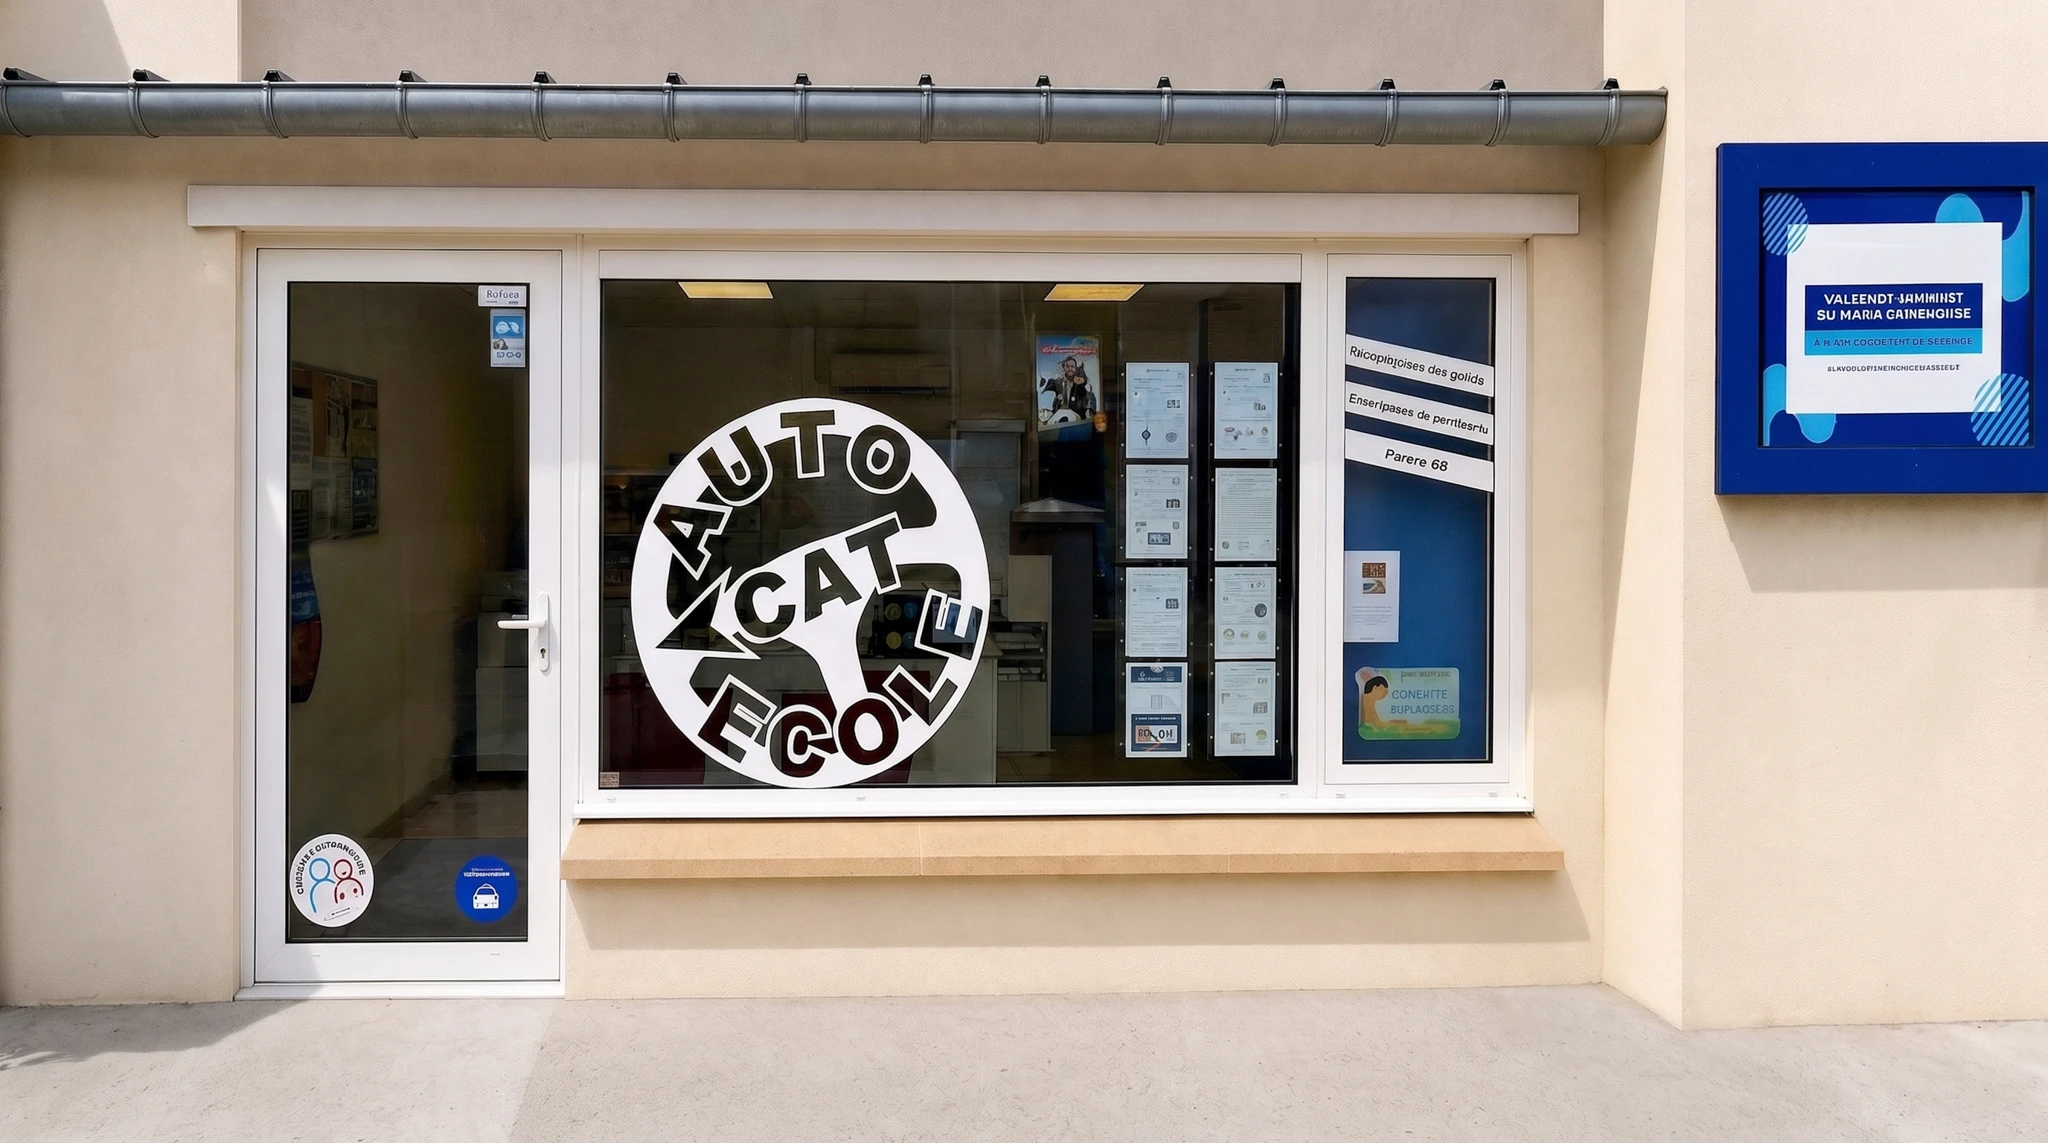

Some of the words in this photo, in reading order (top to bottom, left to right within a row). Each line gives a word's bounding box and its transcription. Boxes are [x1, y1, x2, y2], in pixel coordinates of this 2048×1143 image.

[1816, 309, 1836, 321] SU
[1840, 309, 1882, 320] MARIA
[1912, 338, 1925, 346] DE
[1428, 365, 1448, 378] des
[1450, 371, 1486, 386] golids
[1417, 409, 1431, 421] de
[1384, 448, 1428, 468] Parere
[1431, 458, 1449, 472] 68
[652, 409, 912, 580] AUTO
[734, 513, 903, 643] CAT
[697, 588, 984, 778] ECOLE
